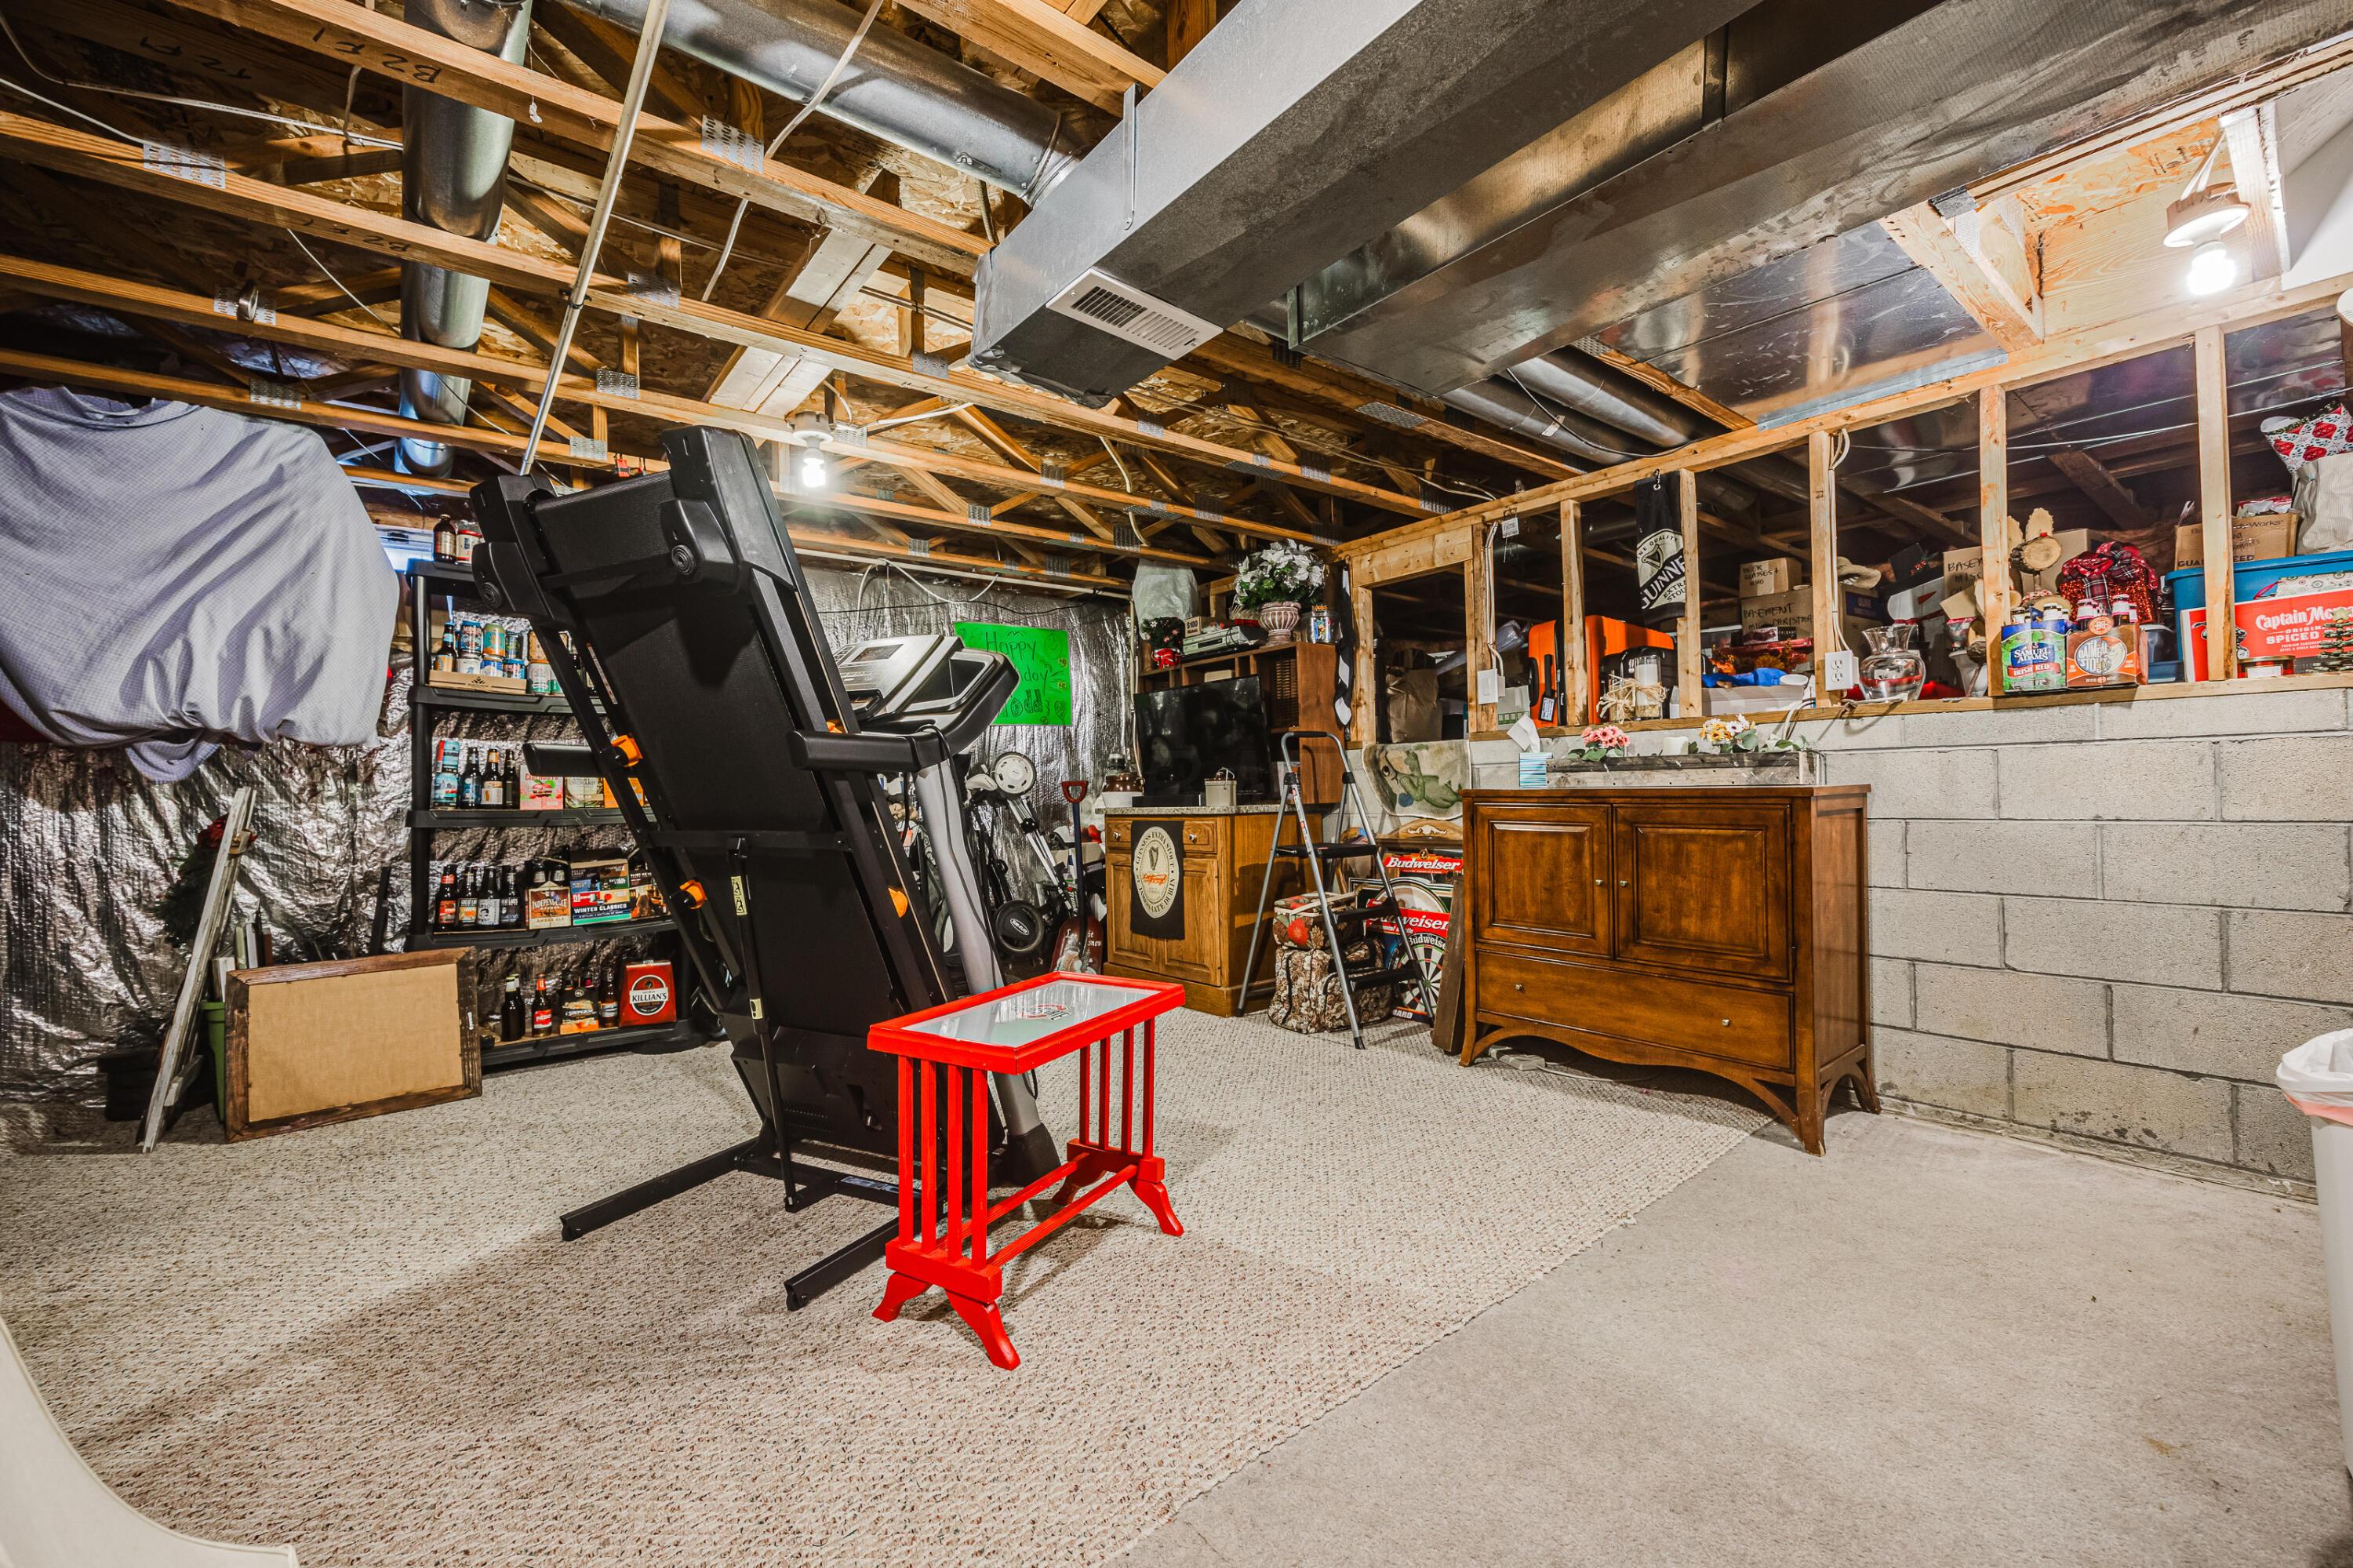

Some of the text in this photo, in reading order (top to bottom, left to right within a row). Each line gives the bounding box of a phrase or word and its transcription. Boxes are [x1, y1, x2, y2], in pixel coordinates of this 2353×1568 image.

[1649, 535, 1678, 546] QUALITY
[1641, 555, 1686, 609] GUINNE
[1663, 581, 1686, 598] EXTR
[1667, 588, 1686, 602] STOU
[1773, 614, 1814, 628] CHRISTMA
[2255, 609, 2306, 631] Captain
[2266, 631, 2320, 645] SPICED
[985, 631, 1037, 662] Happy
[2014, 647, 2051, 658] SAMUEL
[2017, 653, 2049, 664] ADAMS
[2013, 667, 2033, 675] IRISH
[1151, 831, 1166, 845] EXTRA
[1166, 842, 1175, 868] STOUT
[1385, 857, 1460, 870] Budweiser
[1164, 878, 1176, 905] DUBLIN
[1409, 933, 1446, 949] Budweise
[632, 992, 667, 1002] KILLIAN'S
